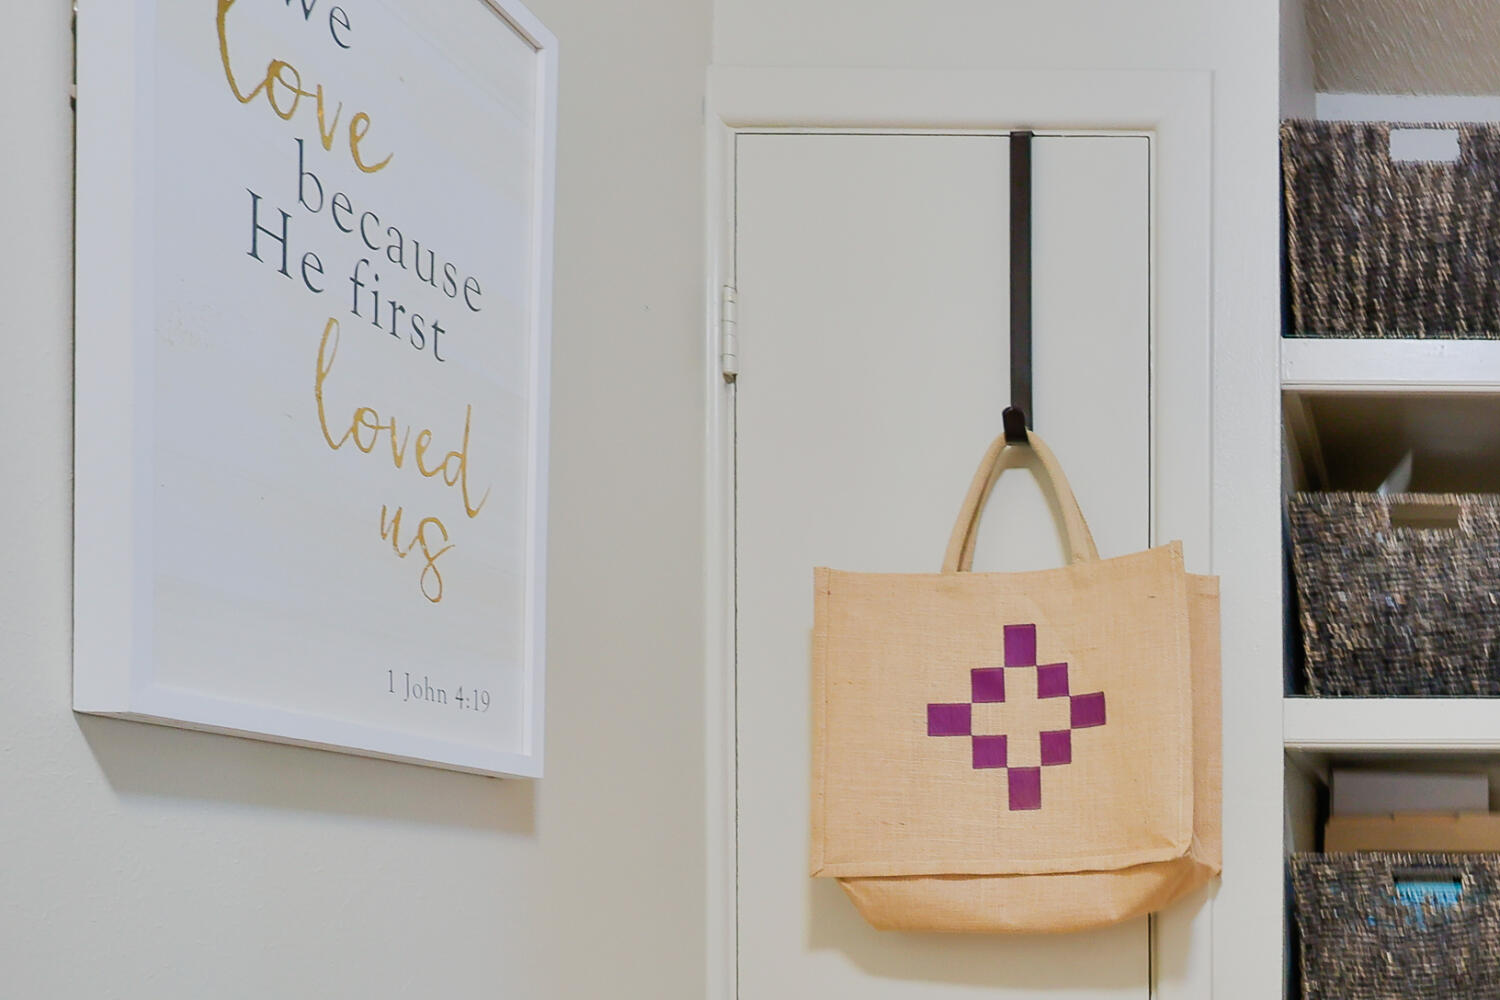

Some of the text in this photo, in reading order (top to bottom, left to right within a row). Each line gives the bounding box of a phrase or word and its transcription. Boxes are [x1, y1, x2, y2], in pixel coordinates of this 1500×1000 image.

[245, 188, 446, 362] He first
[294, 137, 483, 313] because
[314, 317, 491, 518] loved
[380, 504, 455, 603] us
[388, 669, 491, 713] 1 John 4:19
